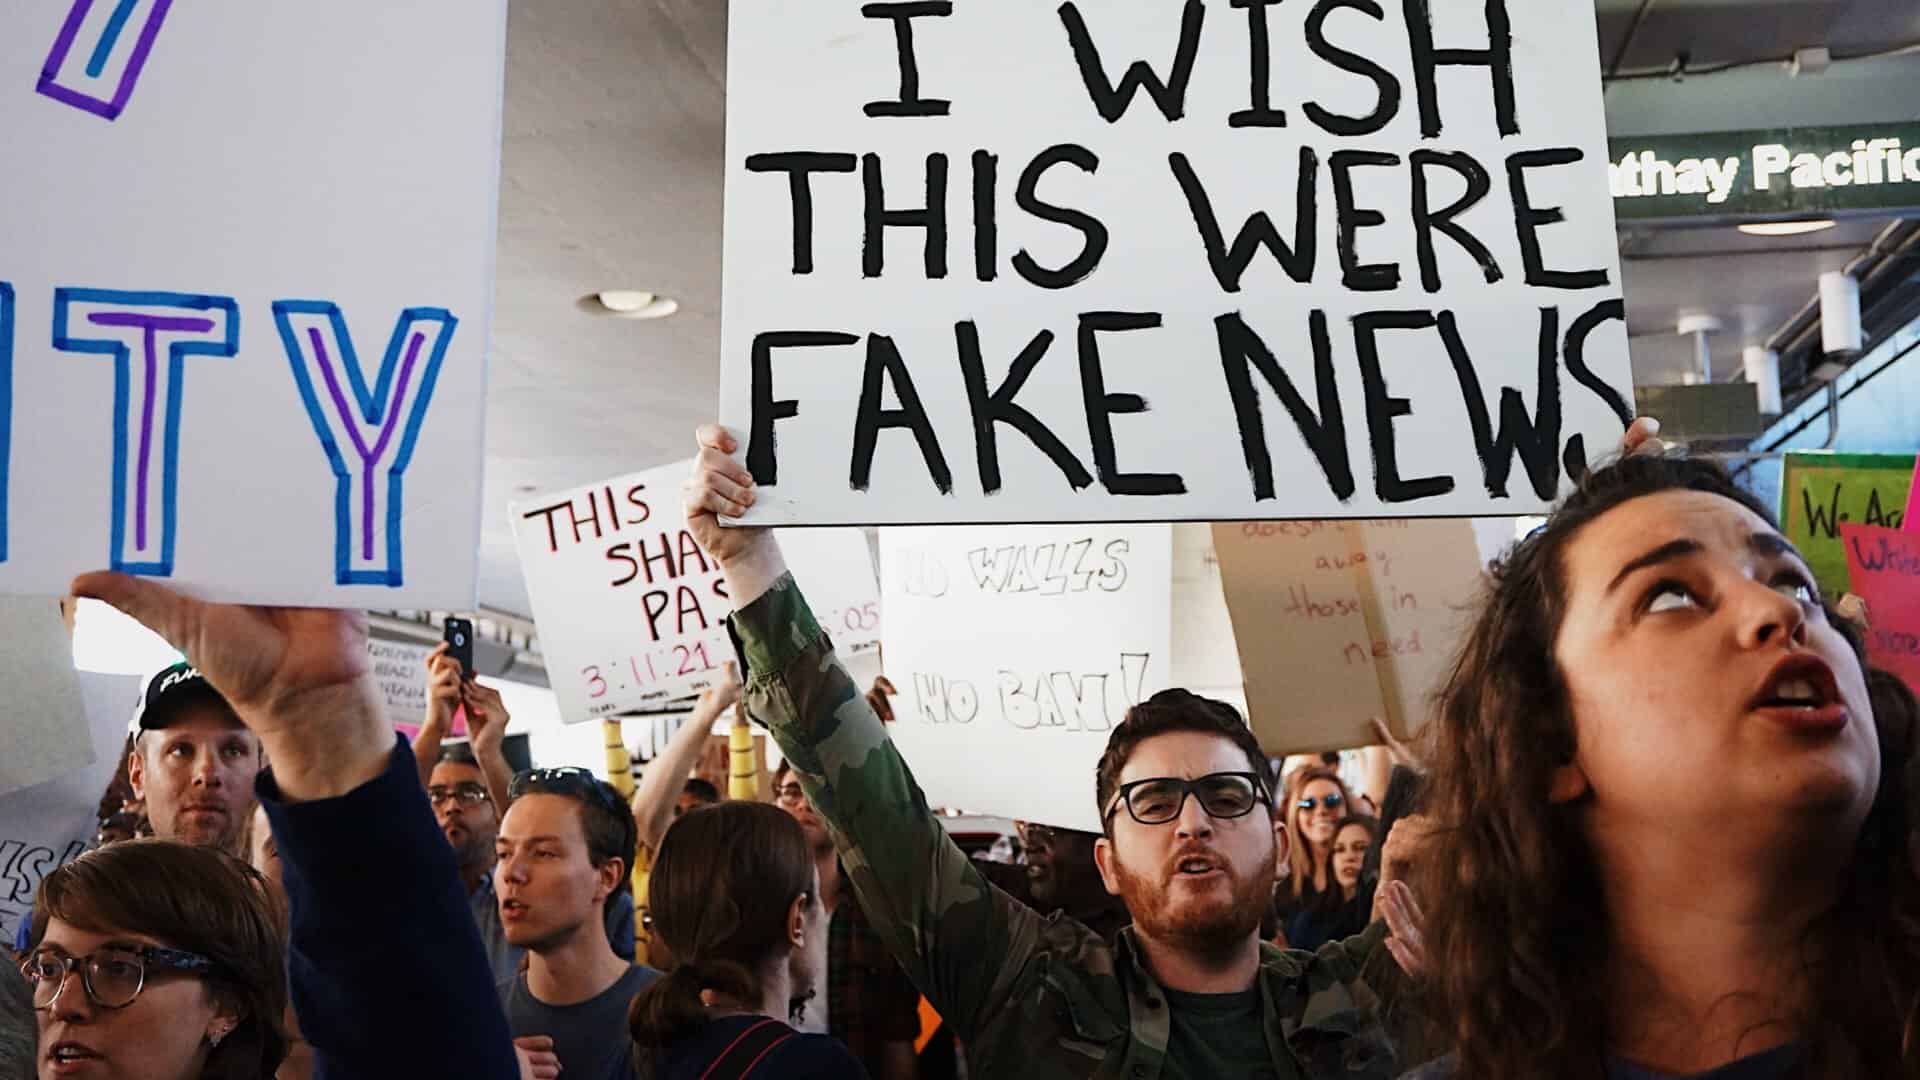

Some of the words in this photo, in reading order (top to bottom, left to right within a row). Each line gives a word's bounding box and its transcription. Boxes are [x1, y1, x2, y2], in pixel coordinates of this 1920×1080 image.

[862, 1, 953, 117] I
[1058, 0, 1519, 139] WISH
[745, 144, 1109, 290] THIS
[1169, 146, 1610, 292] WERE
[0, 280, 459, 588] TY
[745, 311, 1188, 495] FAKE
[1214, 299, 1636, 501] NEWS
[523, 485, 650, 552] THIS
[605, 530, 720, 587] SHA
[967, 538, 1130, 596] WALLS
[912, 671, 979, 724] NO
